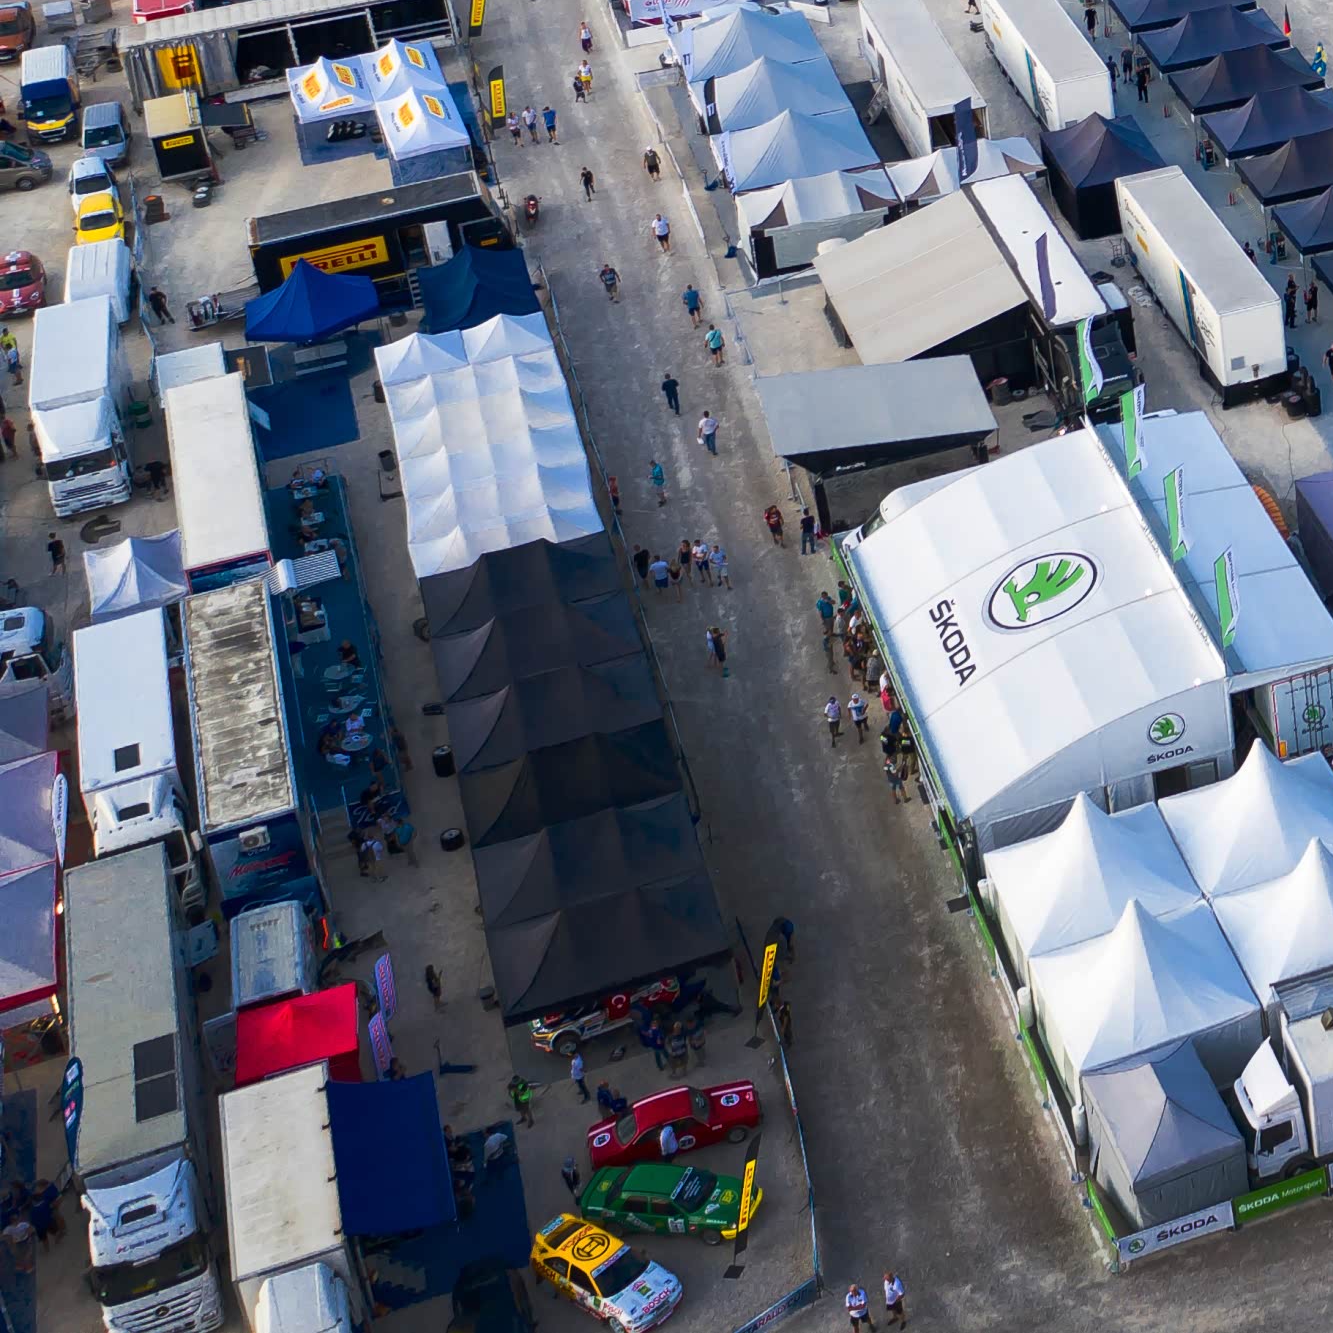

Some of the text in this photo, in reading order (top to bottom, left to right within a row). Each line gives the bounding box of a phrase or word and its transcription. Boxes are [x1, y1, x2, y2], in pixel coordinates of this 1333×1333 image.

[929, 598, 977, 687] ŠKODA
[1146, 743, 1194, 765] ŠKODA
[1238, 1176, 1325, 1215] ŠKODA Motorsport
[1156, 1213, 1220, 1243] ŠKODA
[641, 1286, 672, 1315] BOSCH
